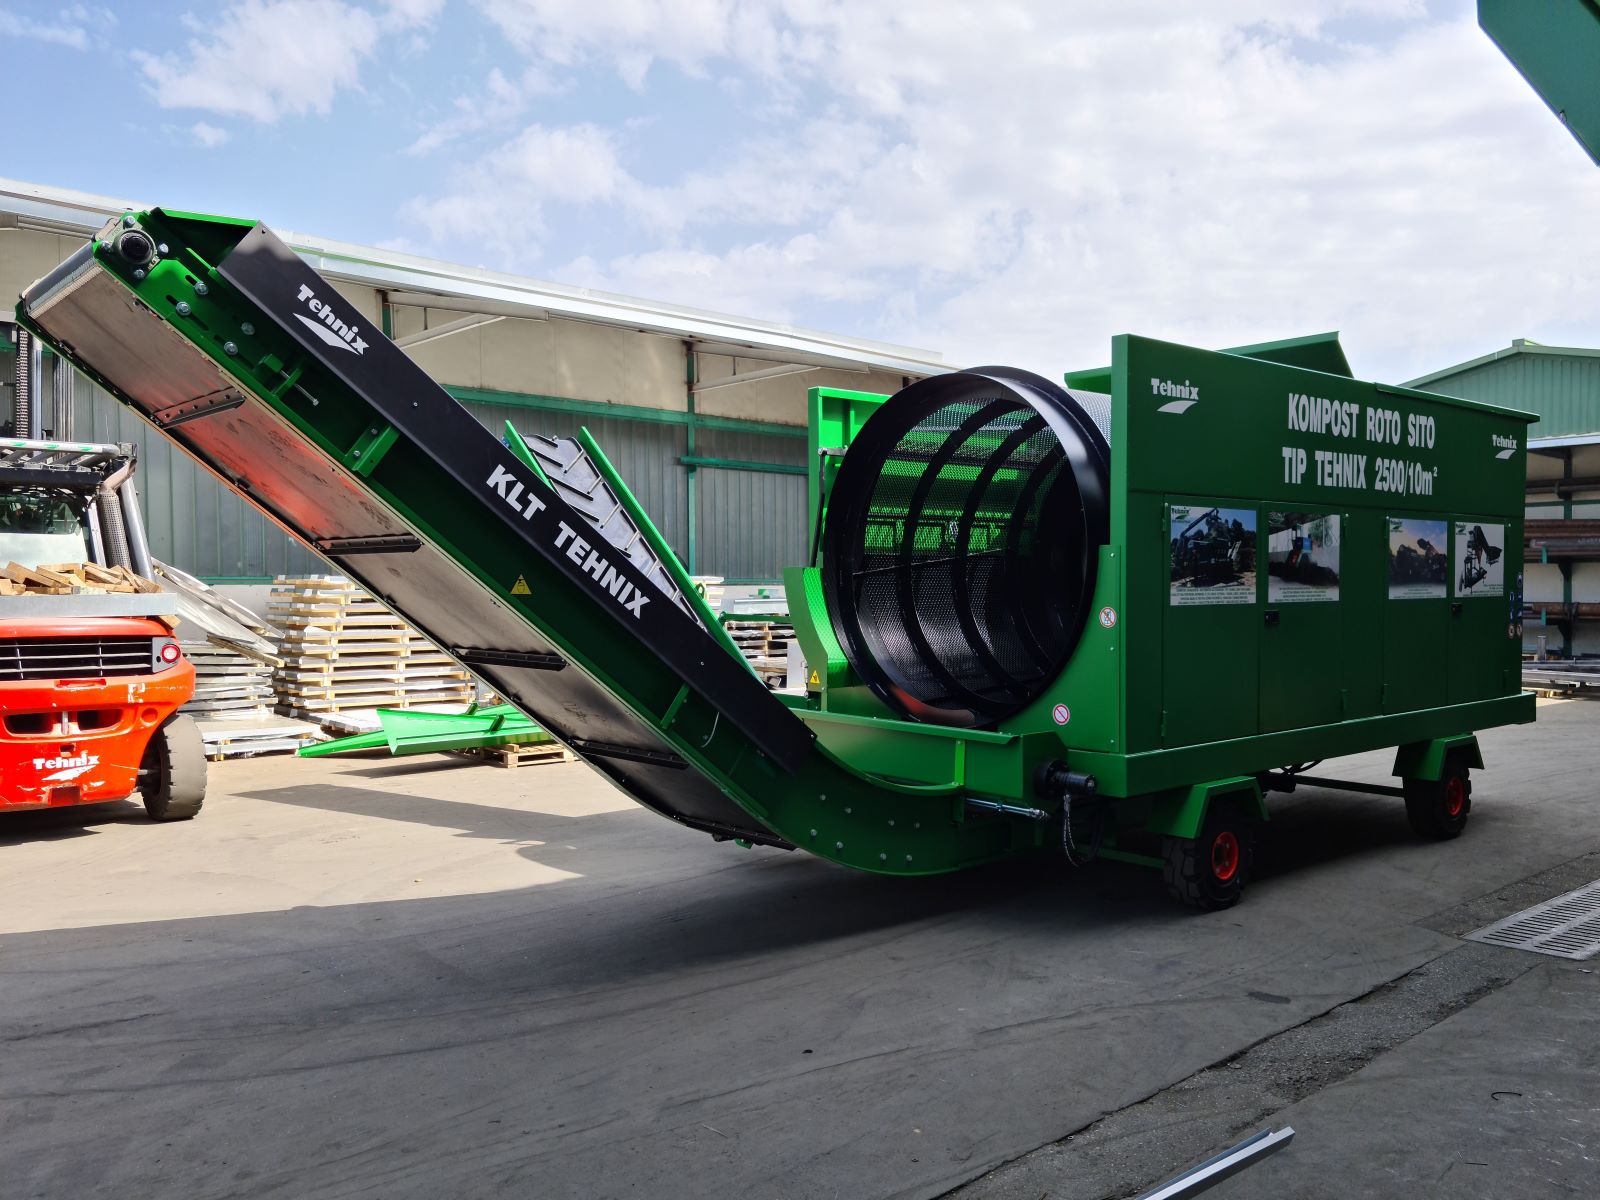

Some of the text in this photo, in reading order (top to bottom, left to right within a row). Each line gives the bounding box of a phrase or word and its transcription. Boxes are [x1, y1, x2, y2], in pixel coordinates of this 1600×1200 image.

[297, 283, 370, 355] Tehnix
[1150, 377, 1199, 400] Tehnix
[1288, 392, 1436, 449] KOMPOST ROTO SITO
[1492, 434, 1517, 449] Tehnix
[1282, 446, 1307, 484] TIP
[1314, 450, 1367, 489] TEHNIX
[486, 463, 651, 620] KLT TEHNIX
[33, 753, 100, 769] Tehnix
